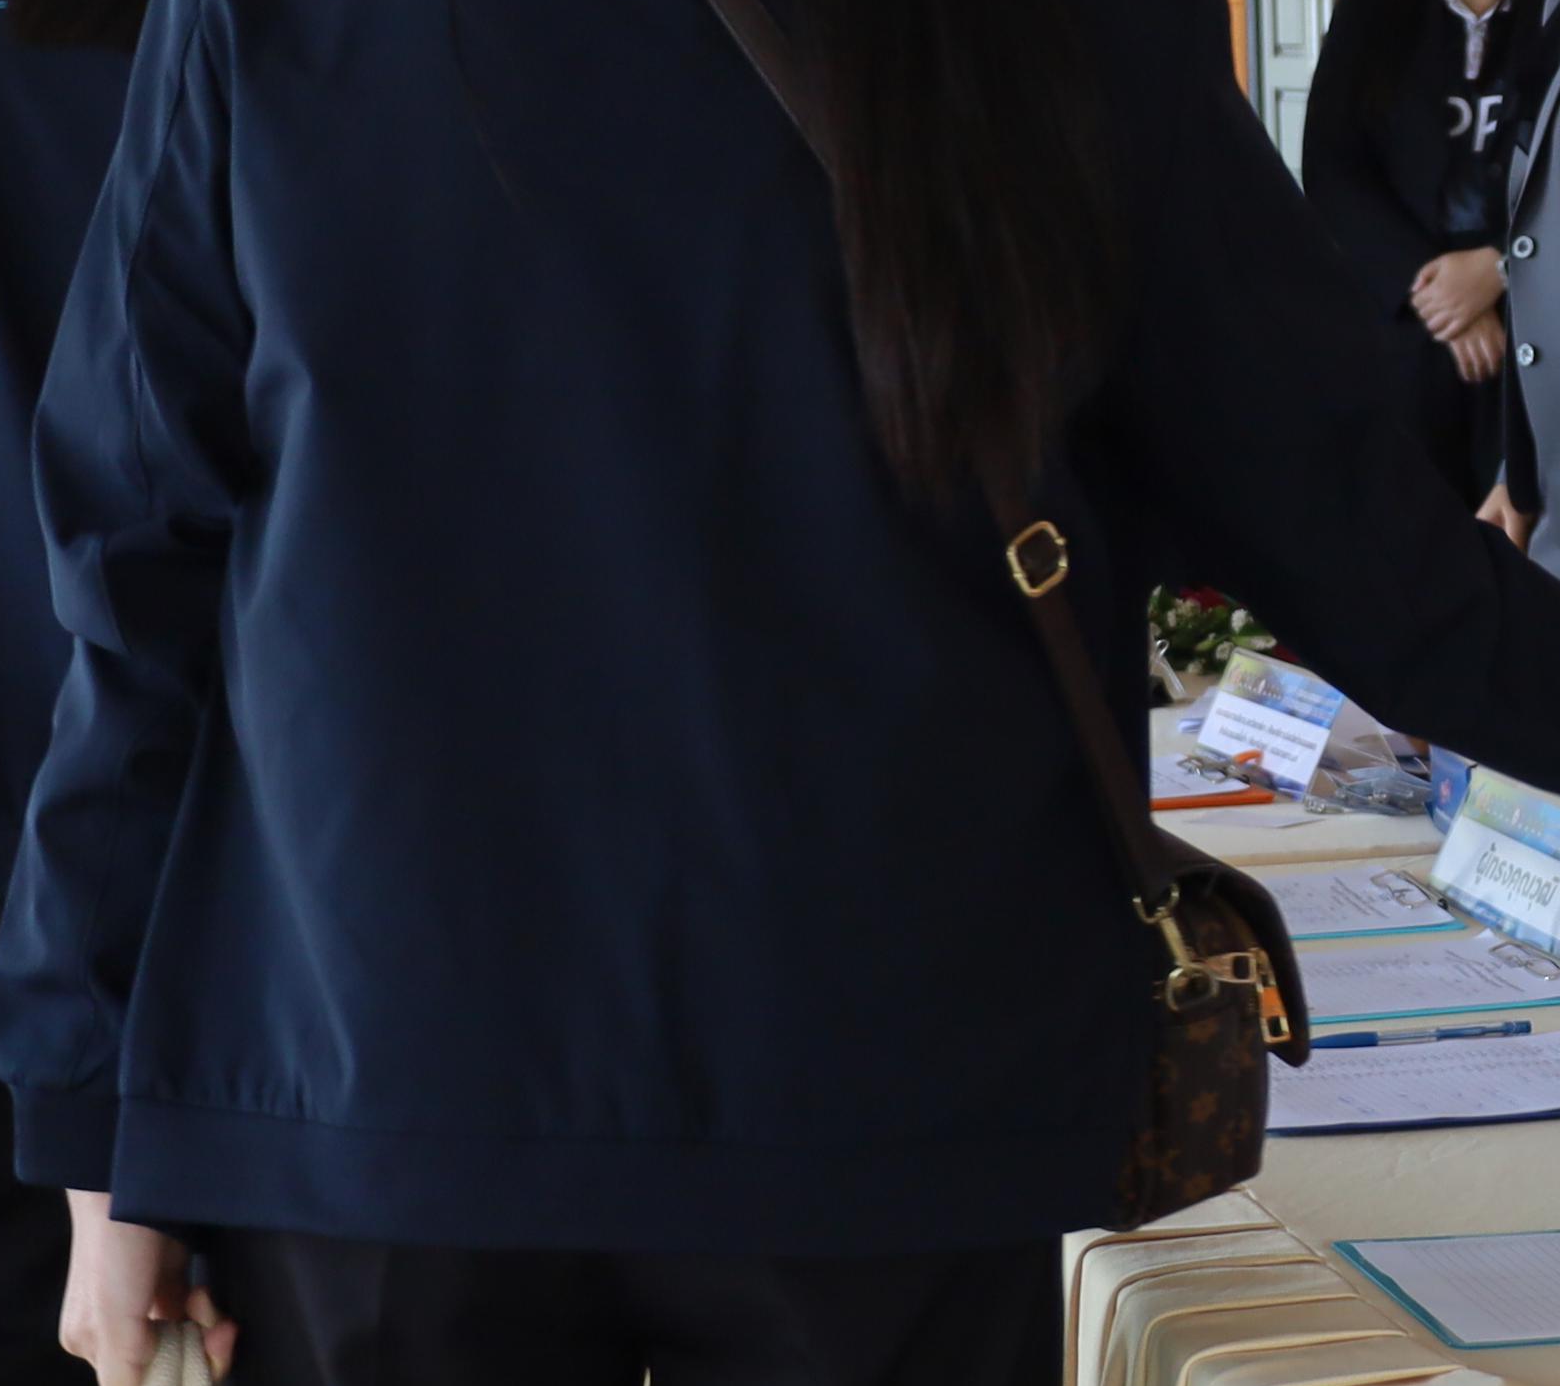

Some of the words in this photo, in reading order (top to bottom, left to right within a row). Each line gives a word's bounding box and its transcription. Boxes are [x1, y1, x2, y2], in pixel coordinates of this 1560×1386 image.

[1475, 842, 1560, 912] ผู้ทรงคุณวุฒิ
